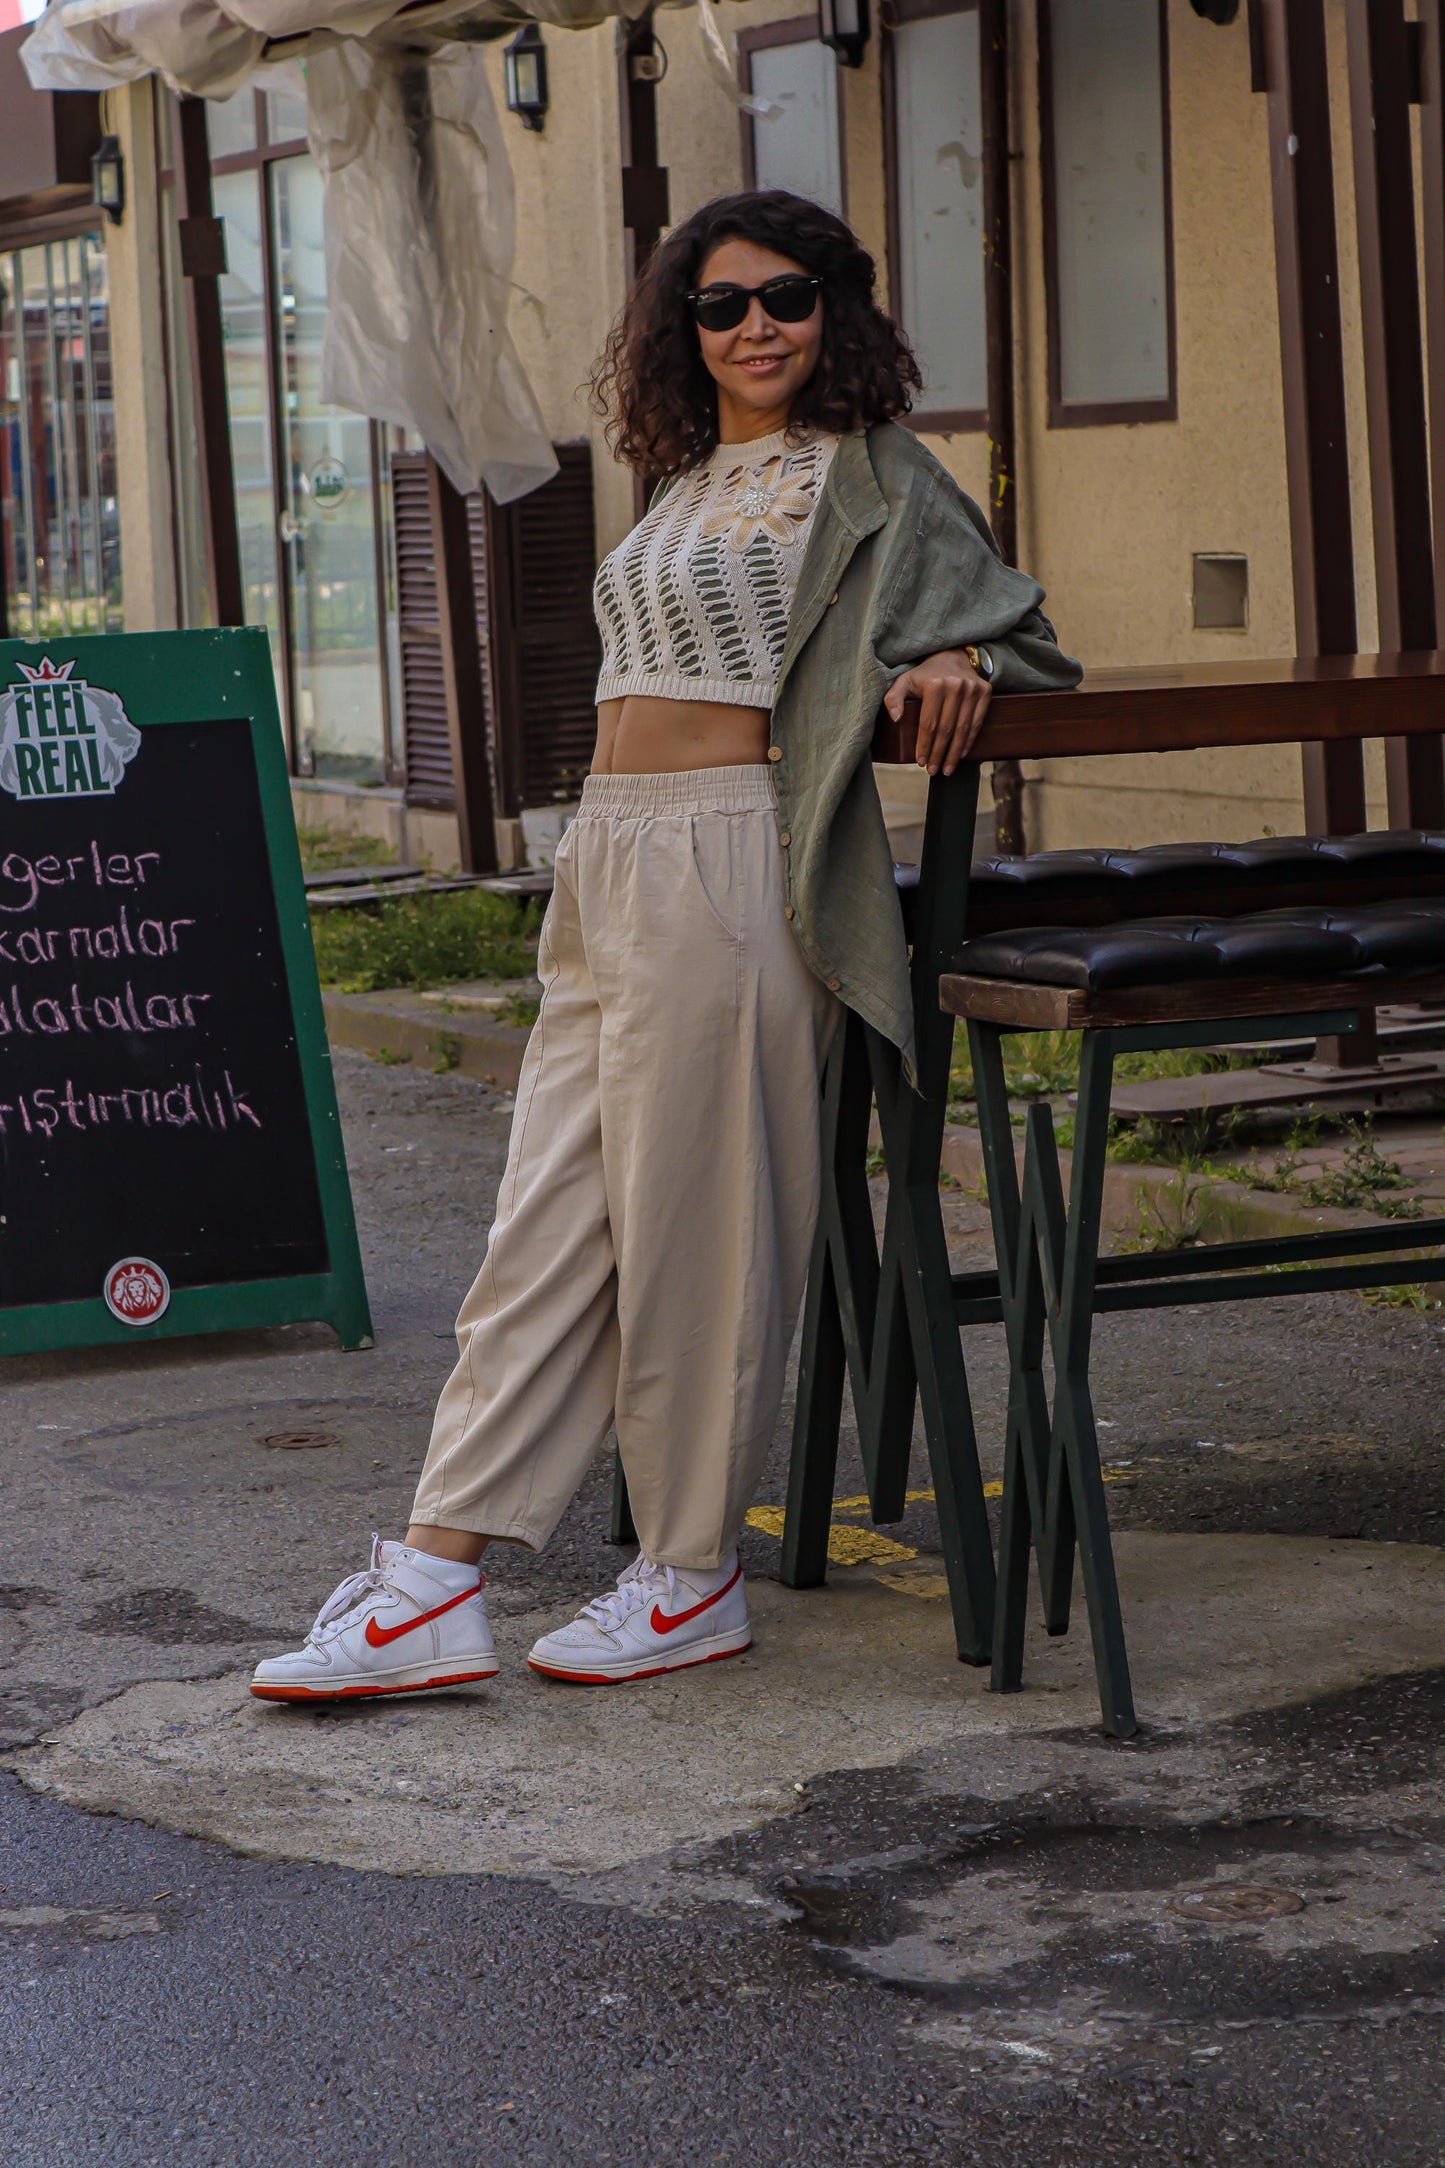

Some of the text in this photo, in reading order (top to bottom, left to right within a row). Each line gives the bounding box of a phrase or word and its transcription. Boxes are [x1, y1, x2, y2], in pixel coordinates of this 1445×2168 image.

[13, 683, 96, 738] FEEL
[14, 739, 111, 795] REAL
[0, 840, 161, 912] gerler
